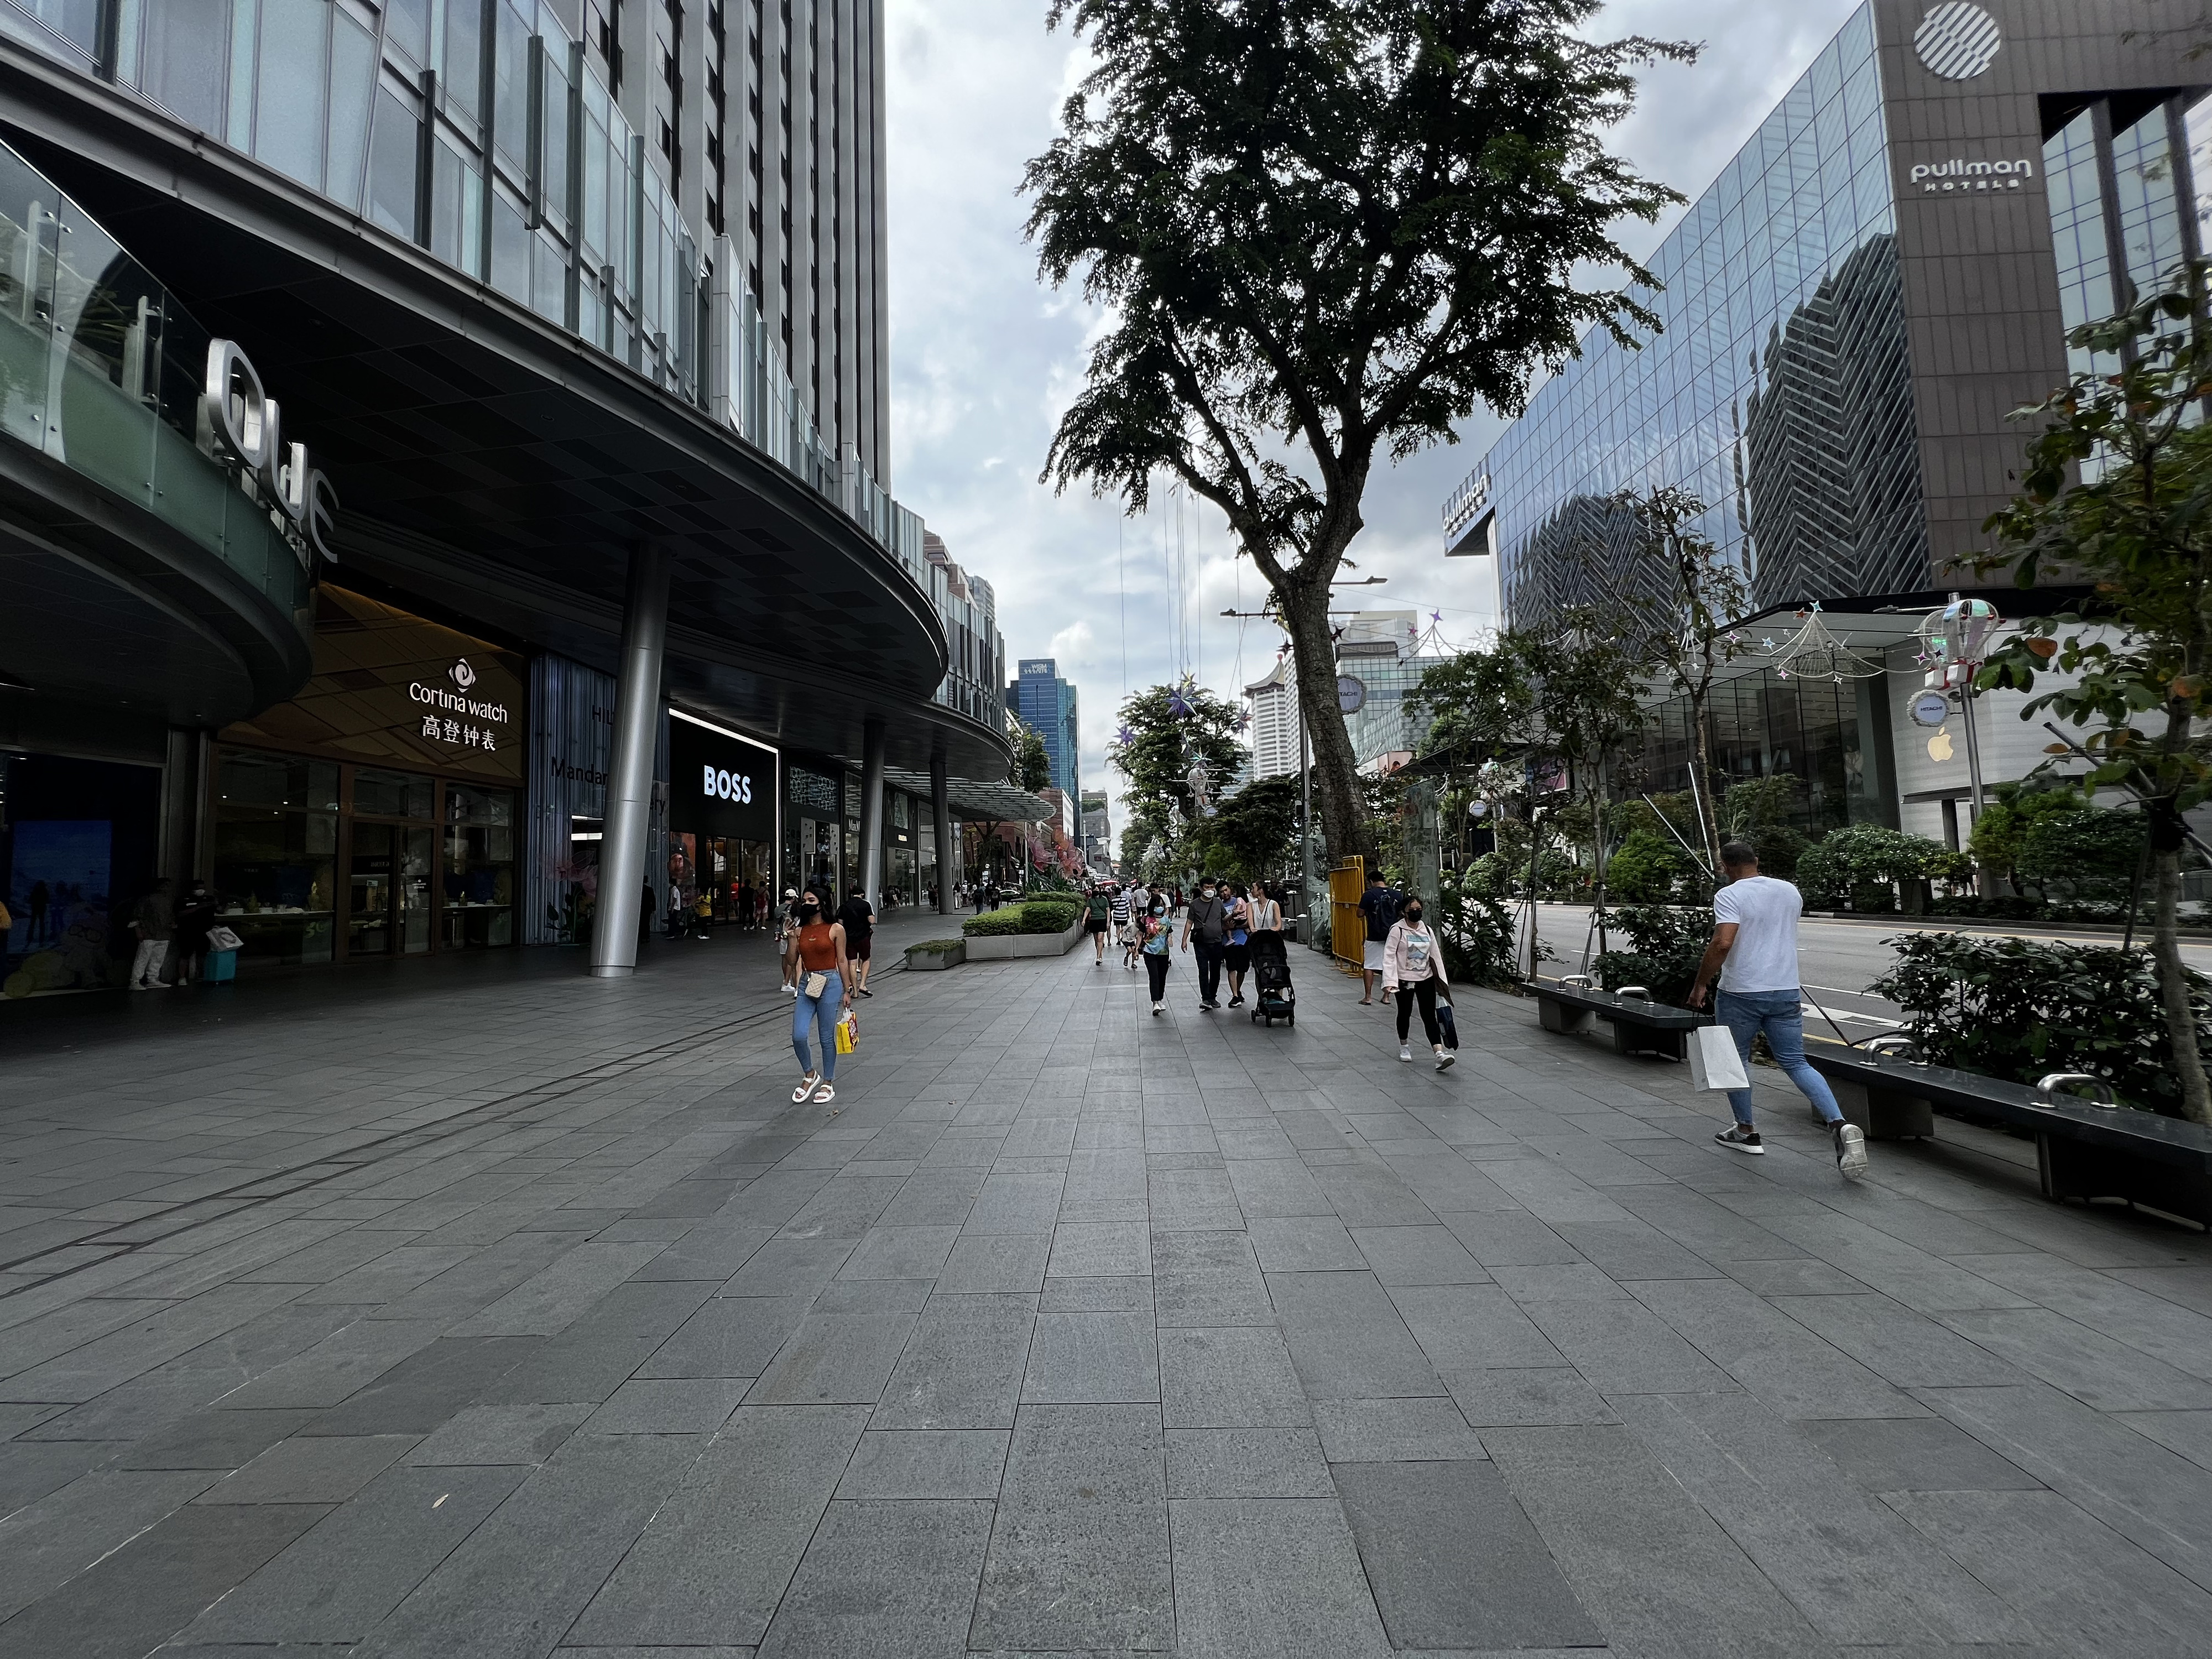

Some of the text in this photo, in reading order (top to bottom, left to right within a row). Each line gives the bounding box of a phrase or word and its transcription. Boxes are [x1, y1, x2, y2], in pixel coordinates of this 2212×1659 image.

[1910, 159, 2032, 184] pullman
[206, 337, 340, 563] OUE
[409, 682, 508, 724] Cortina watch
[592, 705, 615, 727] HIL
[421, 714, 497, 752] 高登钟表
[551, 755, 608, 786] Mandar
[703, 765, 752, 805] BOSS
